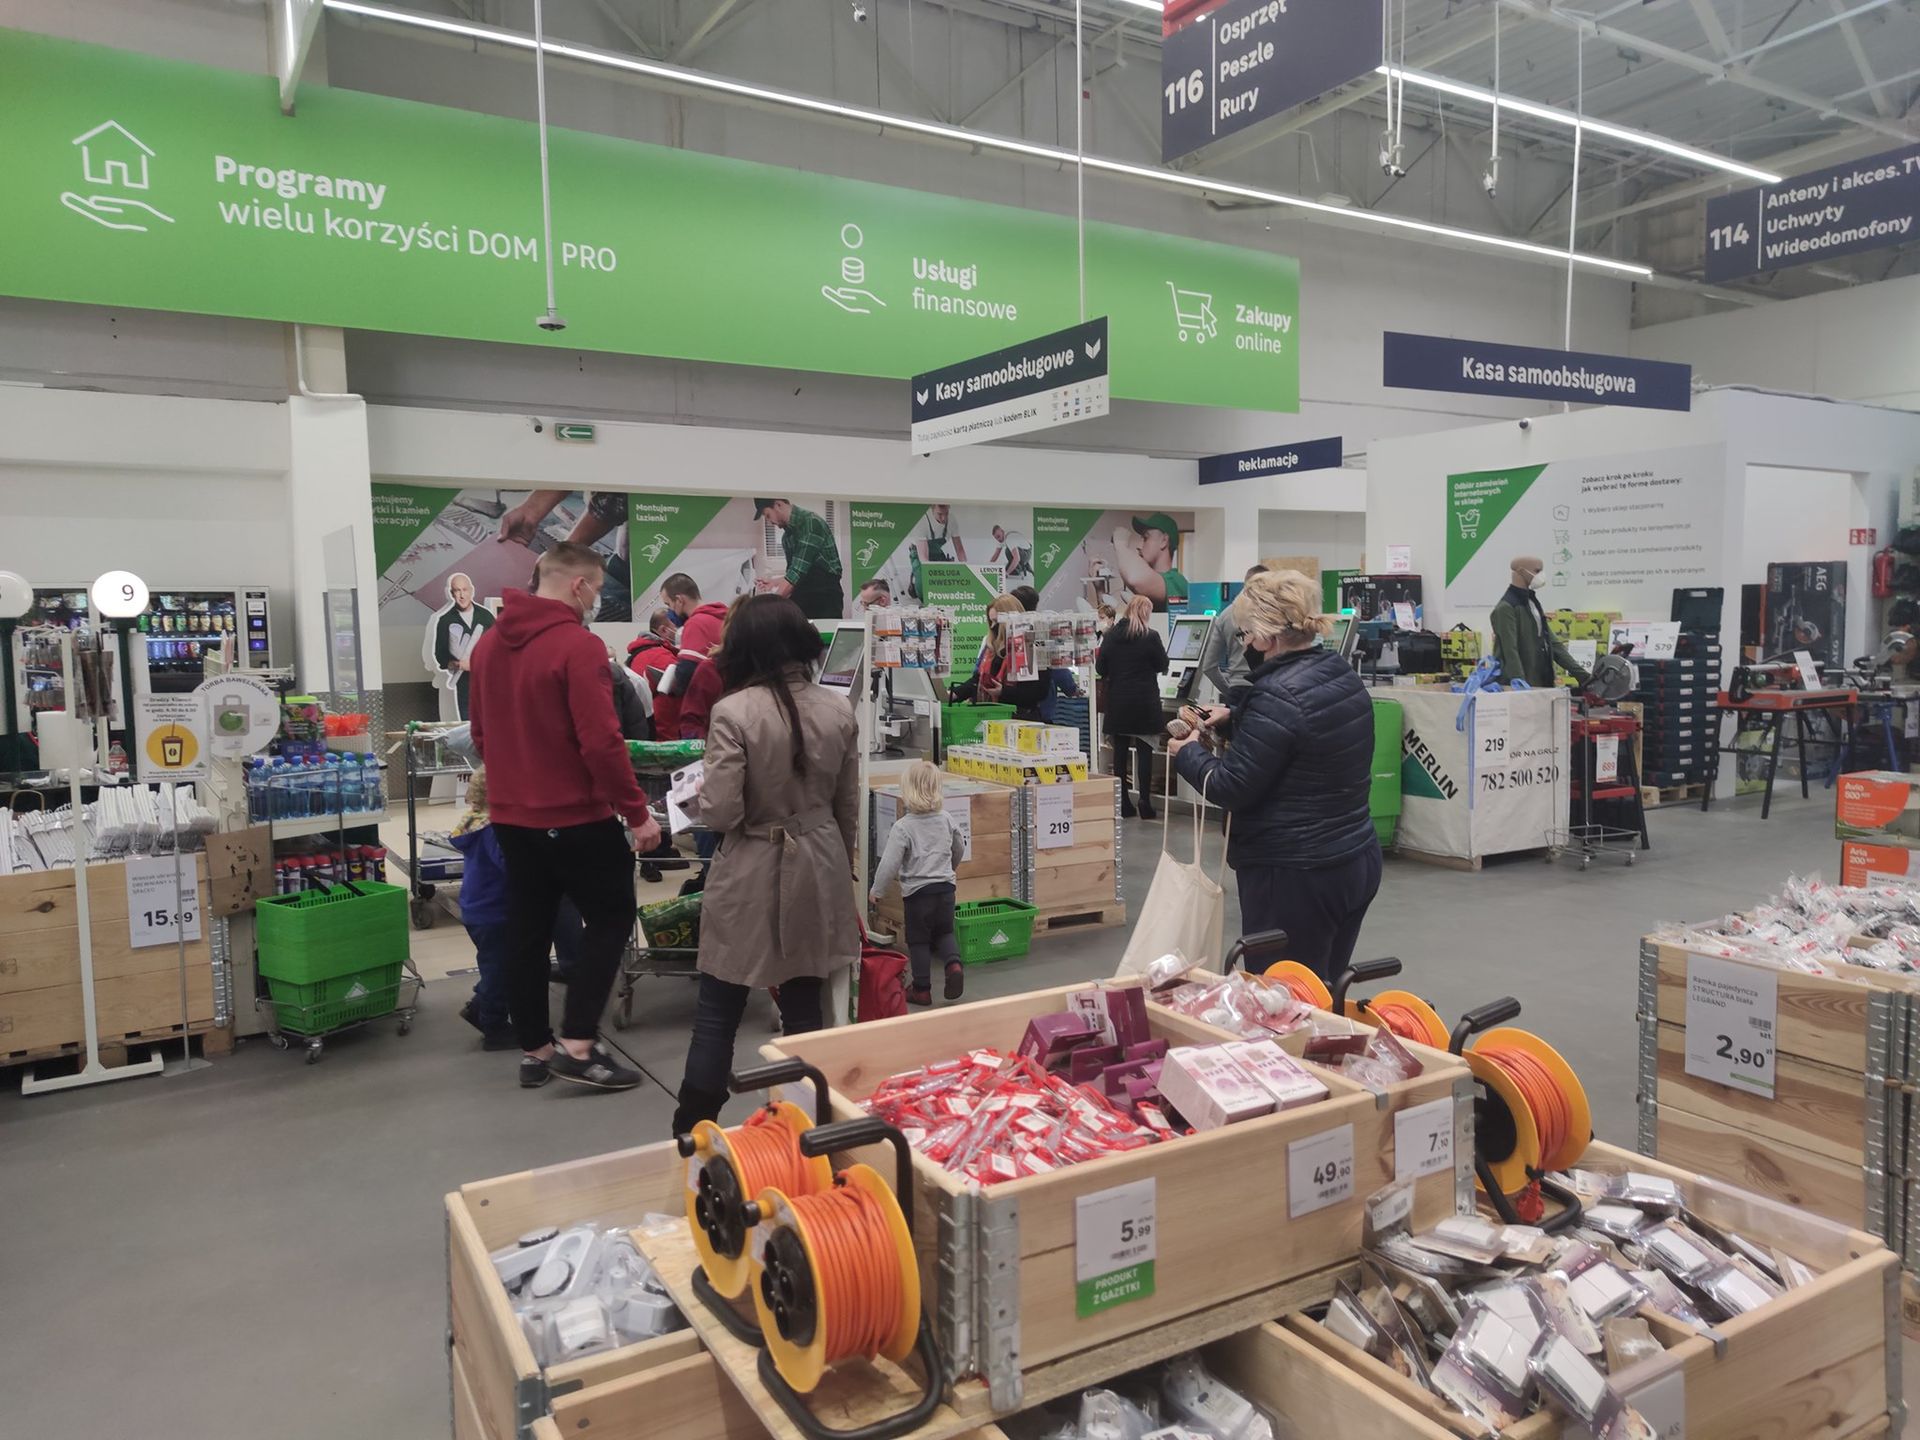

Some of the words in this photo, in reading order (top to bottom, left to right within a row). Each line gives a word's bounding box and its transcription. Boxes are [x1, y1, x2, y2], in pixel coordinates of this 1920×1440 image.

[1219, 0, 1287, 45] Osprzęt
[1219, 41, 1275, 83] Peszle
[1164, 68, 1205, 115] 116
[1219, 87, 1260, 120] Rury
[215, 155, 387, 211] Programy
[1766, 181, 1830, 210] Anteny
[1832, 175, 1839, 193] i
[1841, 163, 1901, 192] akces.
[218, 198, 315, 235] wielu
[324, 207, 459, 252] korzyści
[468, 228, 538, 263] DOM
[562, 241, 617, 272] PRO
[1709, 222, 1750, 251] 114
[1766, 205, 1845, 235] Uchwyty
[1766, 215, 1913, 260] Wideodomofony
[912, 256, 977, 291] Usługi
[912, 286, 1018, 321] finansowe
[1235, 303, 1292, 334] Zakupy
[1235, 331, 1282, 354] online
[935, 377, 967, 402] Kasy
[966, 347, 1076, 394] samoobsługowe
[1462, 356, 1505, 382] Kasa
[1507, 364, 1637, 397] samoobsługowa
[1238, 451, 1299, 473] Reklamacje
[371, 495, 414, 506] ontujemy
[121, 583, 135, 602] 9
[1815, 565, 1828, 592] AEG
[1484, 737, 1505, 753] 219
[1404, 728, 1459, 800] MERLIN
[1480, 772, 1506, 793] 782
[1509, 768, 1533, 790] 500
[1536, 765, 1560, 785] 520
[1049, 820, 1071, 835] 219
[1716, 1034, 1766, 1068] 2,90
[1092, 1293, 1101, 1305] Z
[1100, 1281, 1141, 1303] GAZETKI
[1094, 1267, 1139, 1291] PRODUKT
